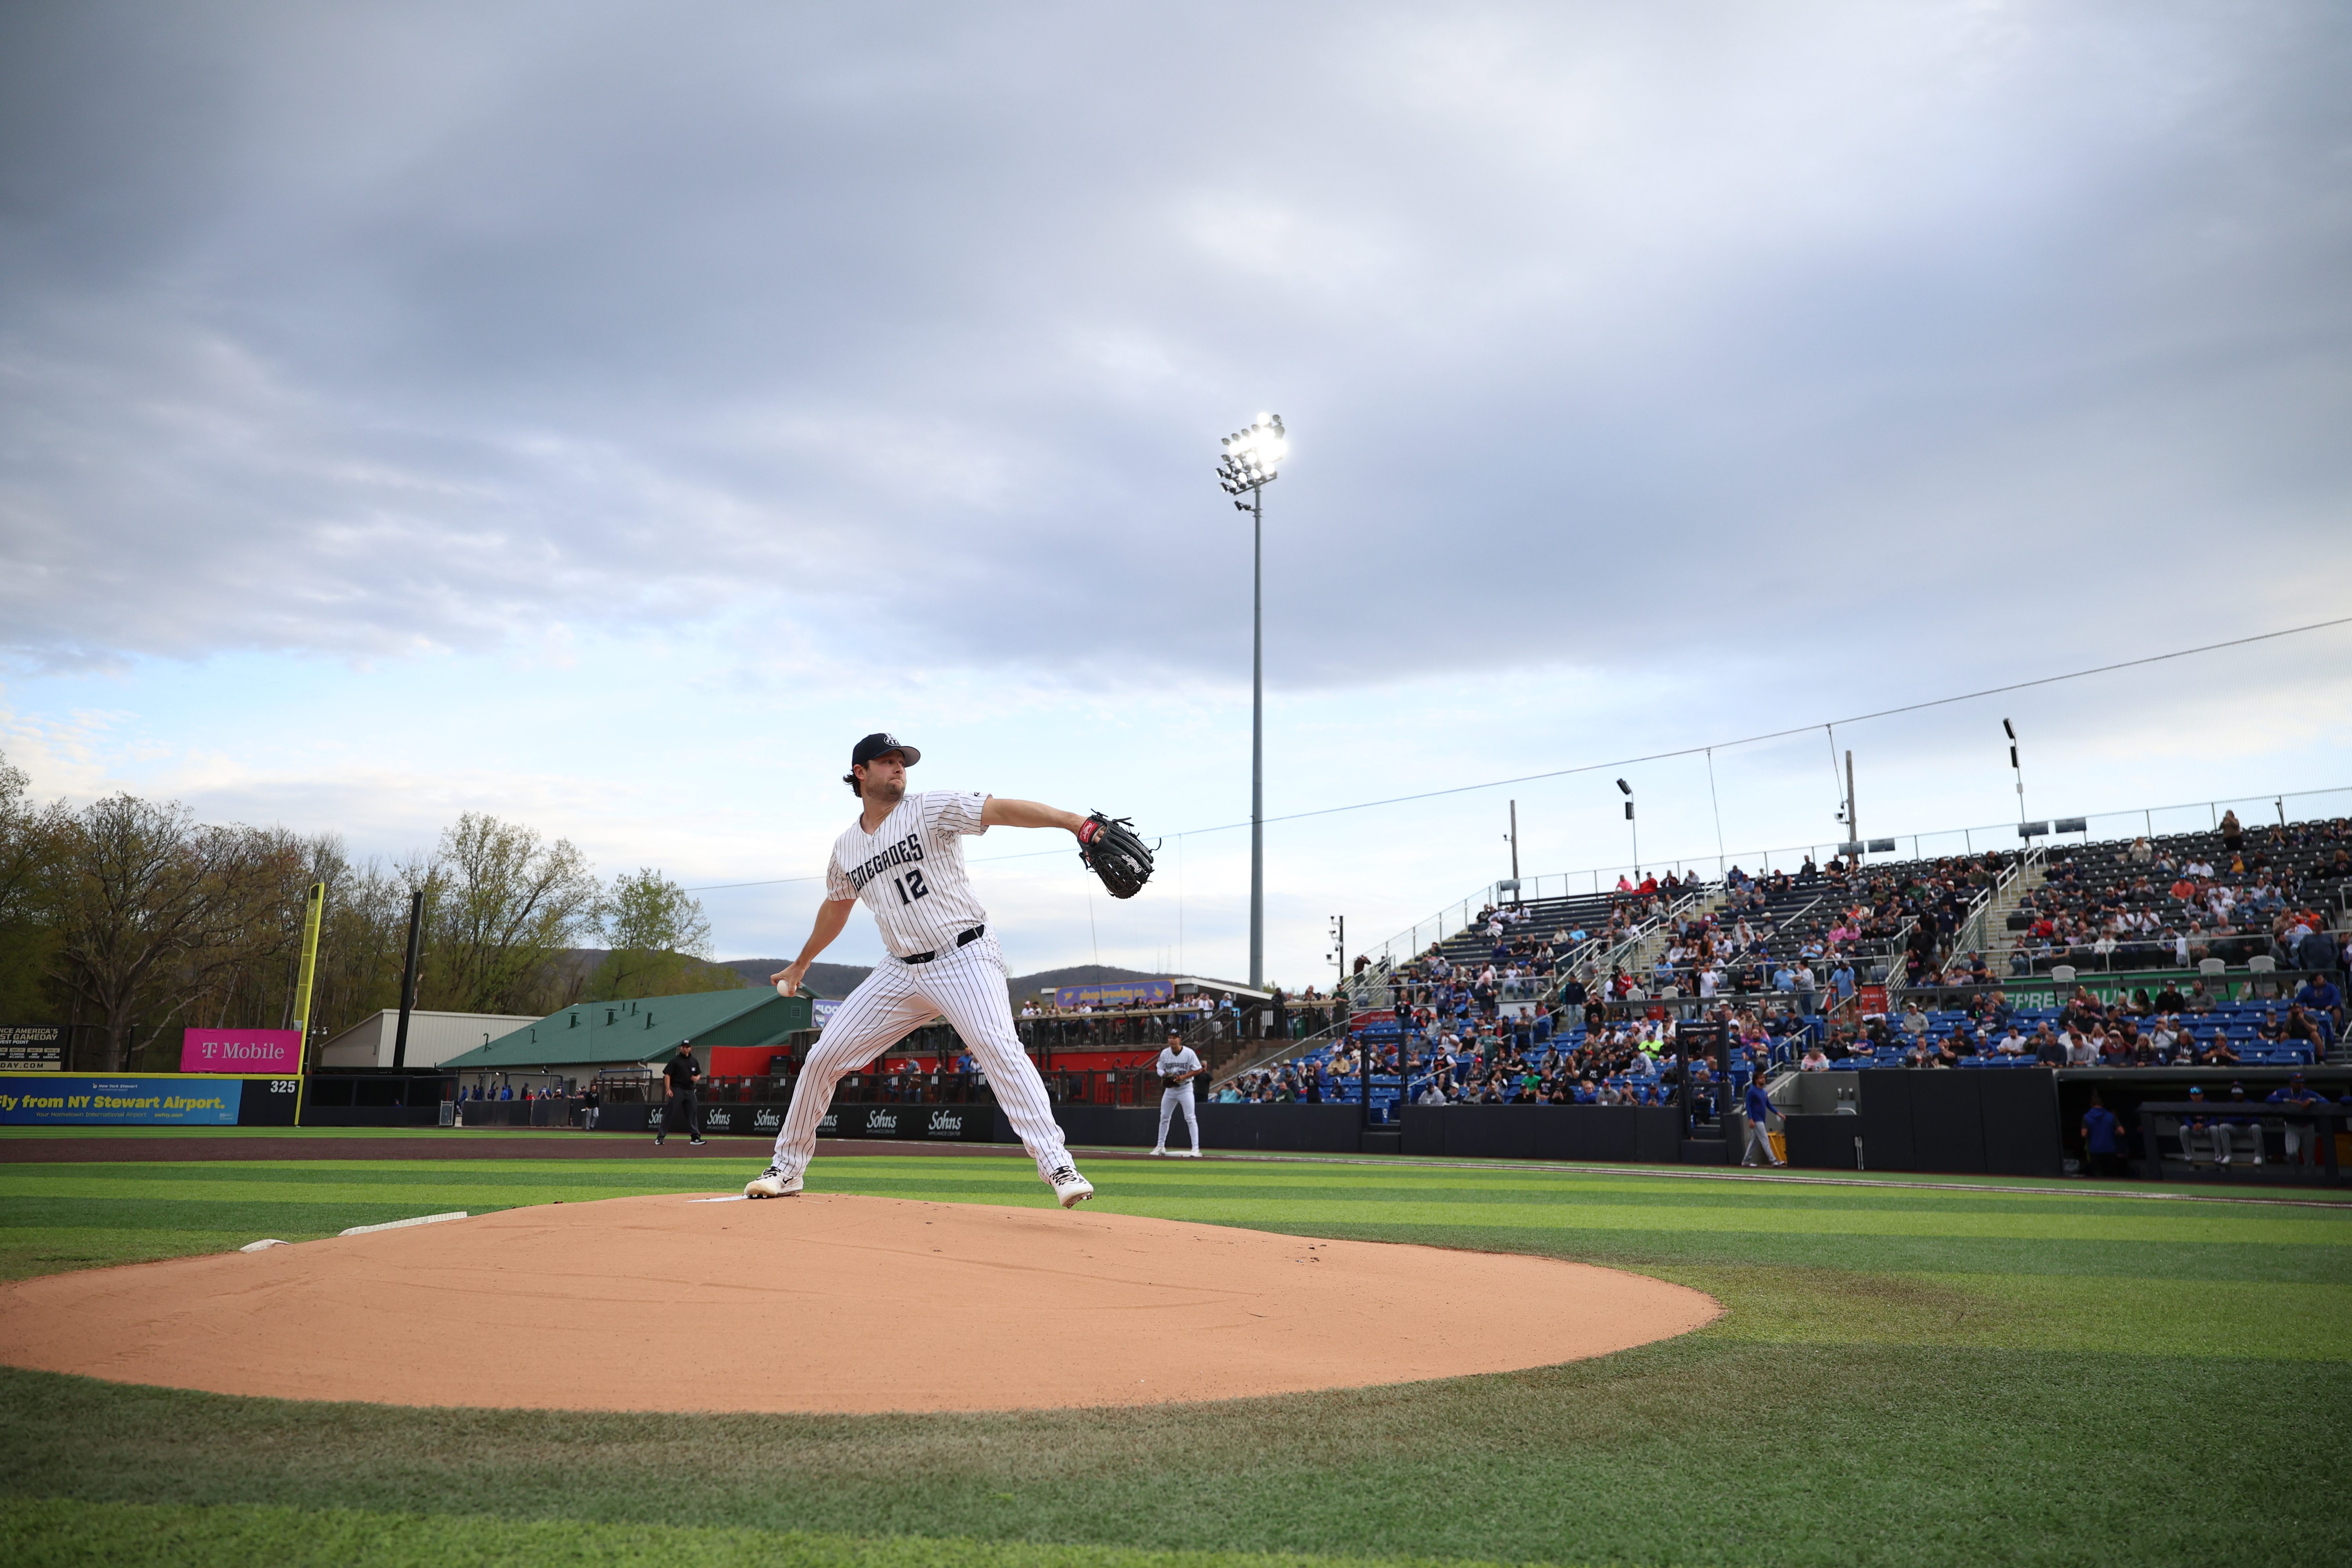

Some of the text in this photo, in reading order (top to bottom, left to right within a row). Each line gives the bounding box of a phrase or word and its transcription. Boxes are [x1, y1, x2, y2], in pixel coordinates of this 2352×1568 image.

[1121, 855, 1142, 873] Rawlings
[894, 869, 929, 905] 12
[1080, 987, 1146, 1002] sloop brewing co.
[815, 1004, 839, 1014] SLOO
[221, 1043, 284, 1059] Mobile
[270, 1080, 296, 1093] 325
[22, 1095, 64, 1108] from
[67, 1096, 91, 1108] NY
[94, 1096, 160, 1108] Stewart
[163, 1096, 225, 1111] Airport.
[648, 1107, 663, 1124] Soh
[707, 1108, 731, 1125] Sohns
[754, 1109, 780, 1126] Sohns
[818, 1114, 838, 1127] hns
[866, 1109, 897, 1128] Sohns
[928, 1110, 962, 1130] Sohns
